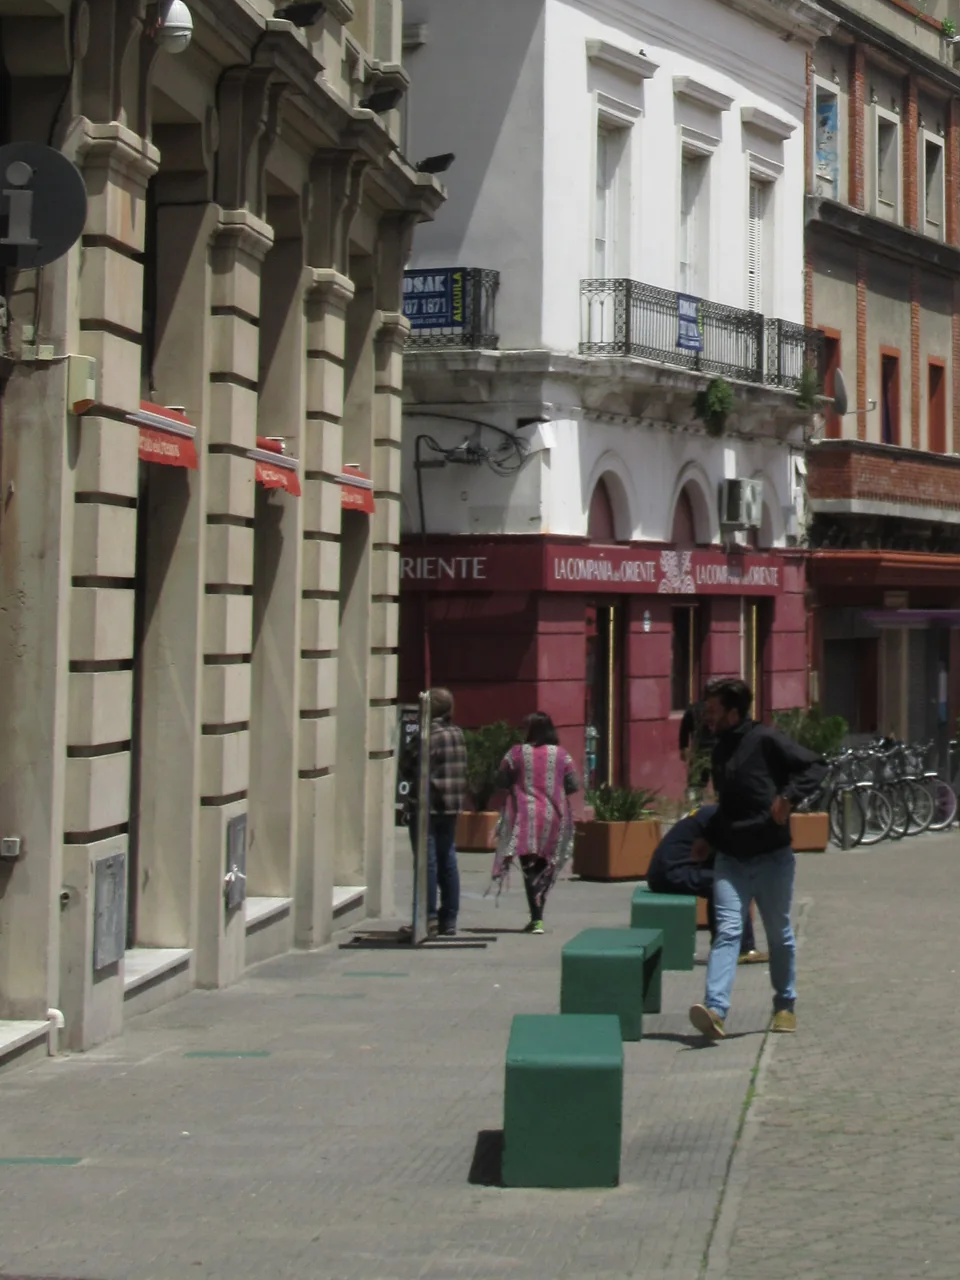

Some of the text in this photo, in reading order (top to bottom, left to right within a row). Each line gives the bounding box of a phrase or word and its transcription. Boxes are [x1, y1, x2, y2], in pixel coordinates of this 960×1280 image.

[421, 298, 446, 313] 1871
[453, 272, 462, 321] ALQUILA
[555, 558, 566, 579] LA
[621, 561, 656, 582] ORIENTE
